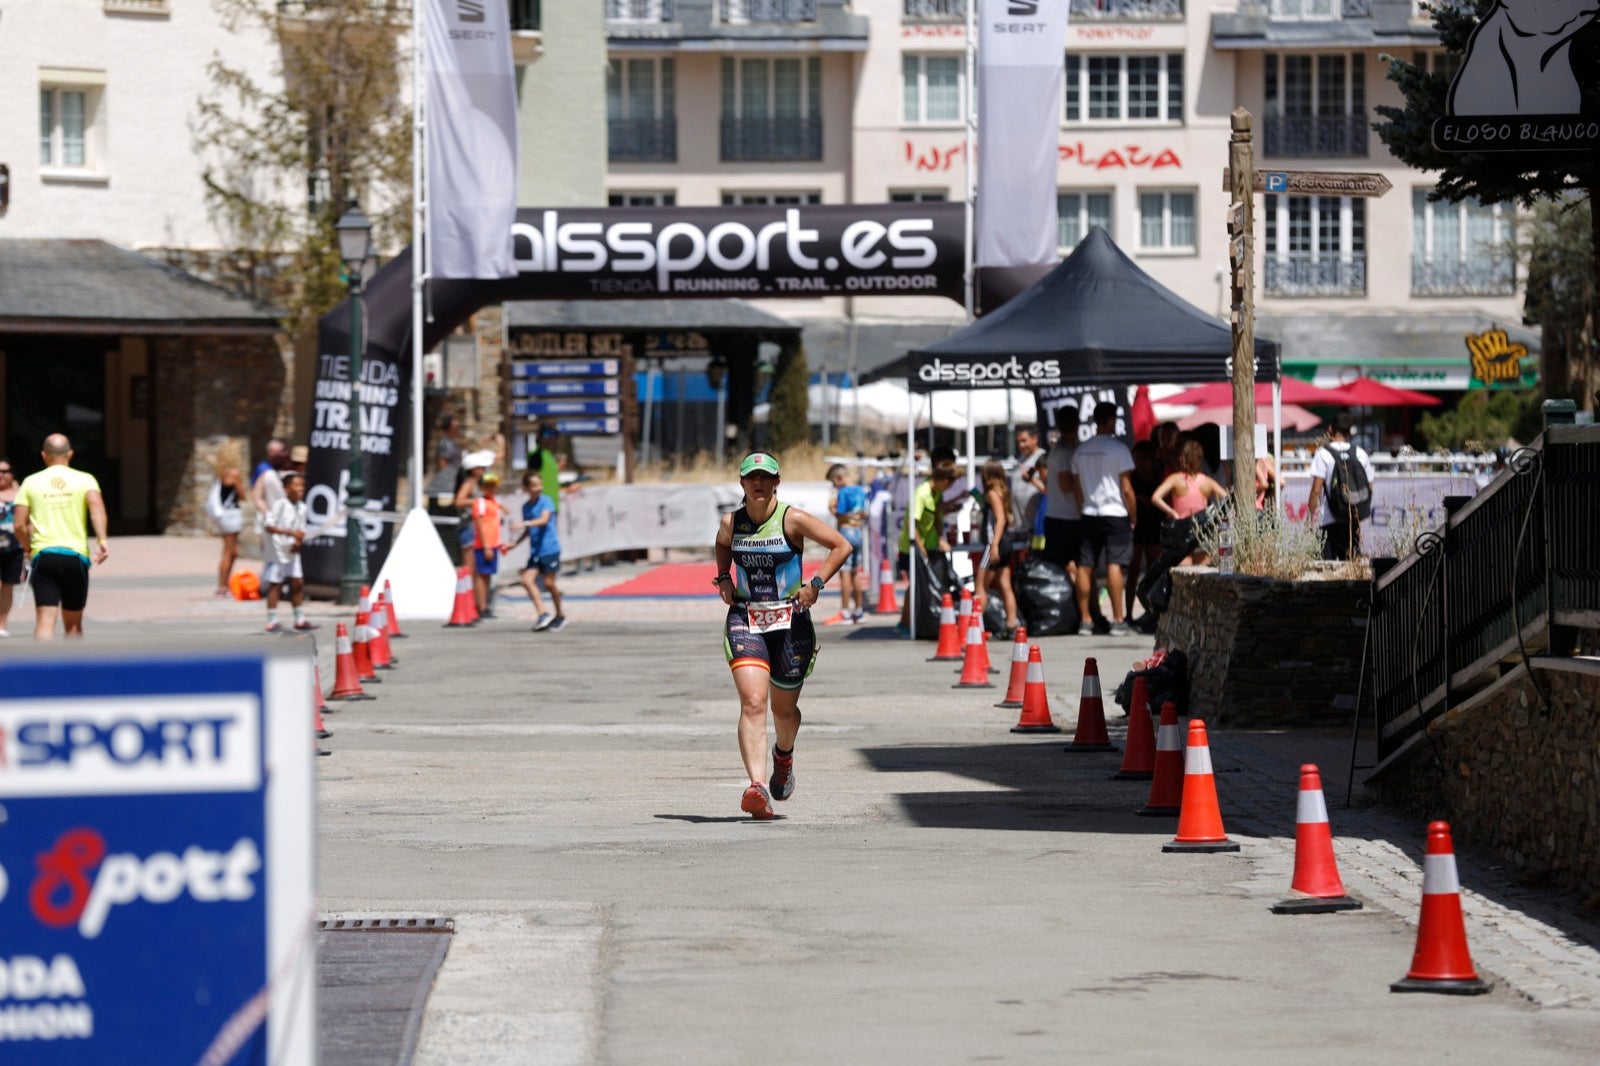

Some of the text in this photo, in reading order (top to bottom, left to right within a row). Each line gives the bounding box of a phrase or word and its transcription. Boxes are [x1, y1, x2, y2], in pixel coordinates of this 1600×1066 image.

[449, 29, 496, 40] SEAT
[992, 22, 1047, 34] SEAT
[1520, 122, 1599, 142] BLANCO
[1269, 175, 1377, 192] P Aparcamiento
[510, 208, 938, 293] alssport.es
[589, 275, 937, 294] TIENDA RUNNING TRAIL OUTDOOR
[918, 355, 1062, 387] alssport.es
[741, 554, 774, 568] SANTOS
[753, 608, 789, 625] 263
[0, 713, 238, 768] SPORT
